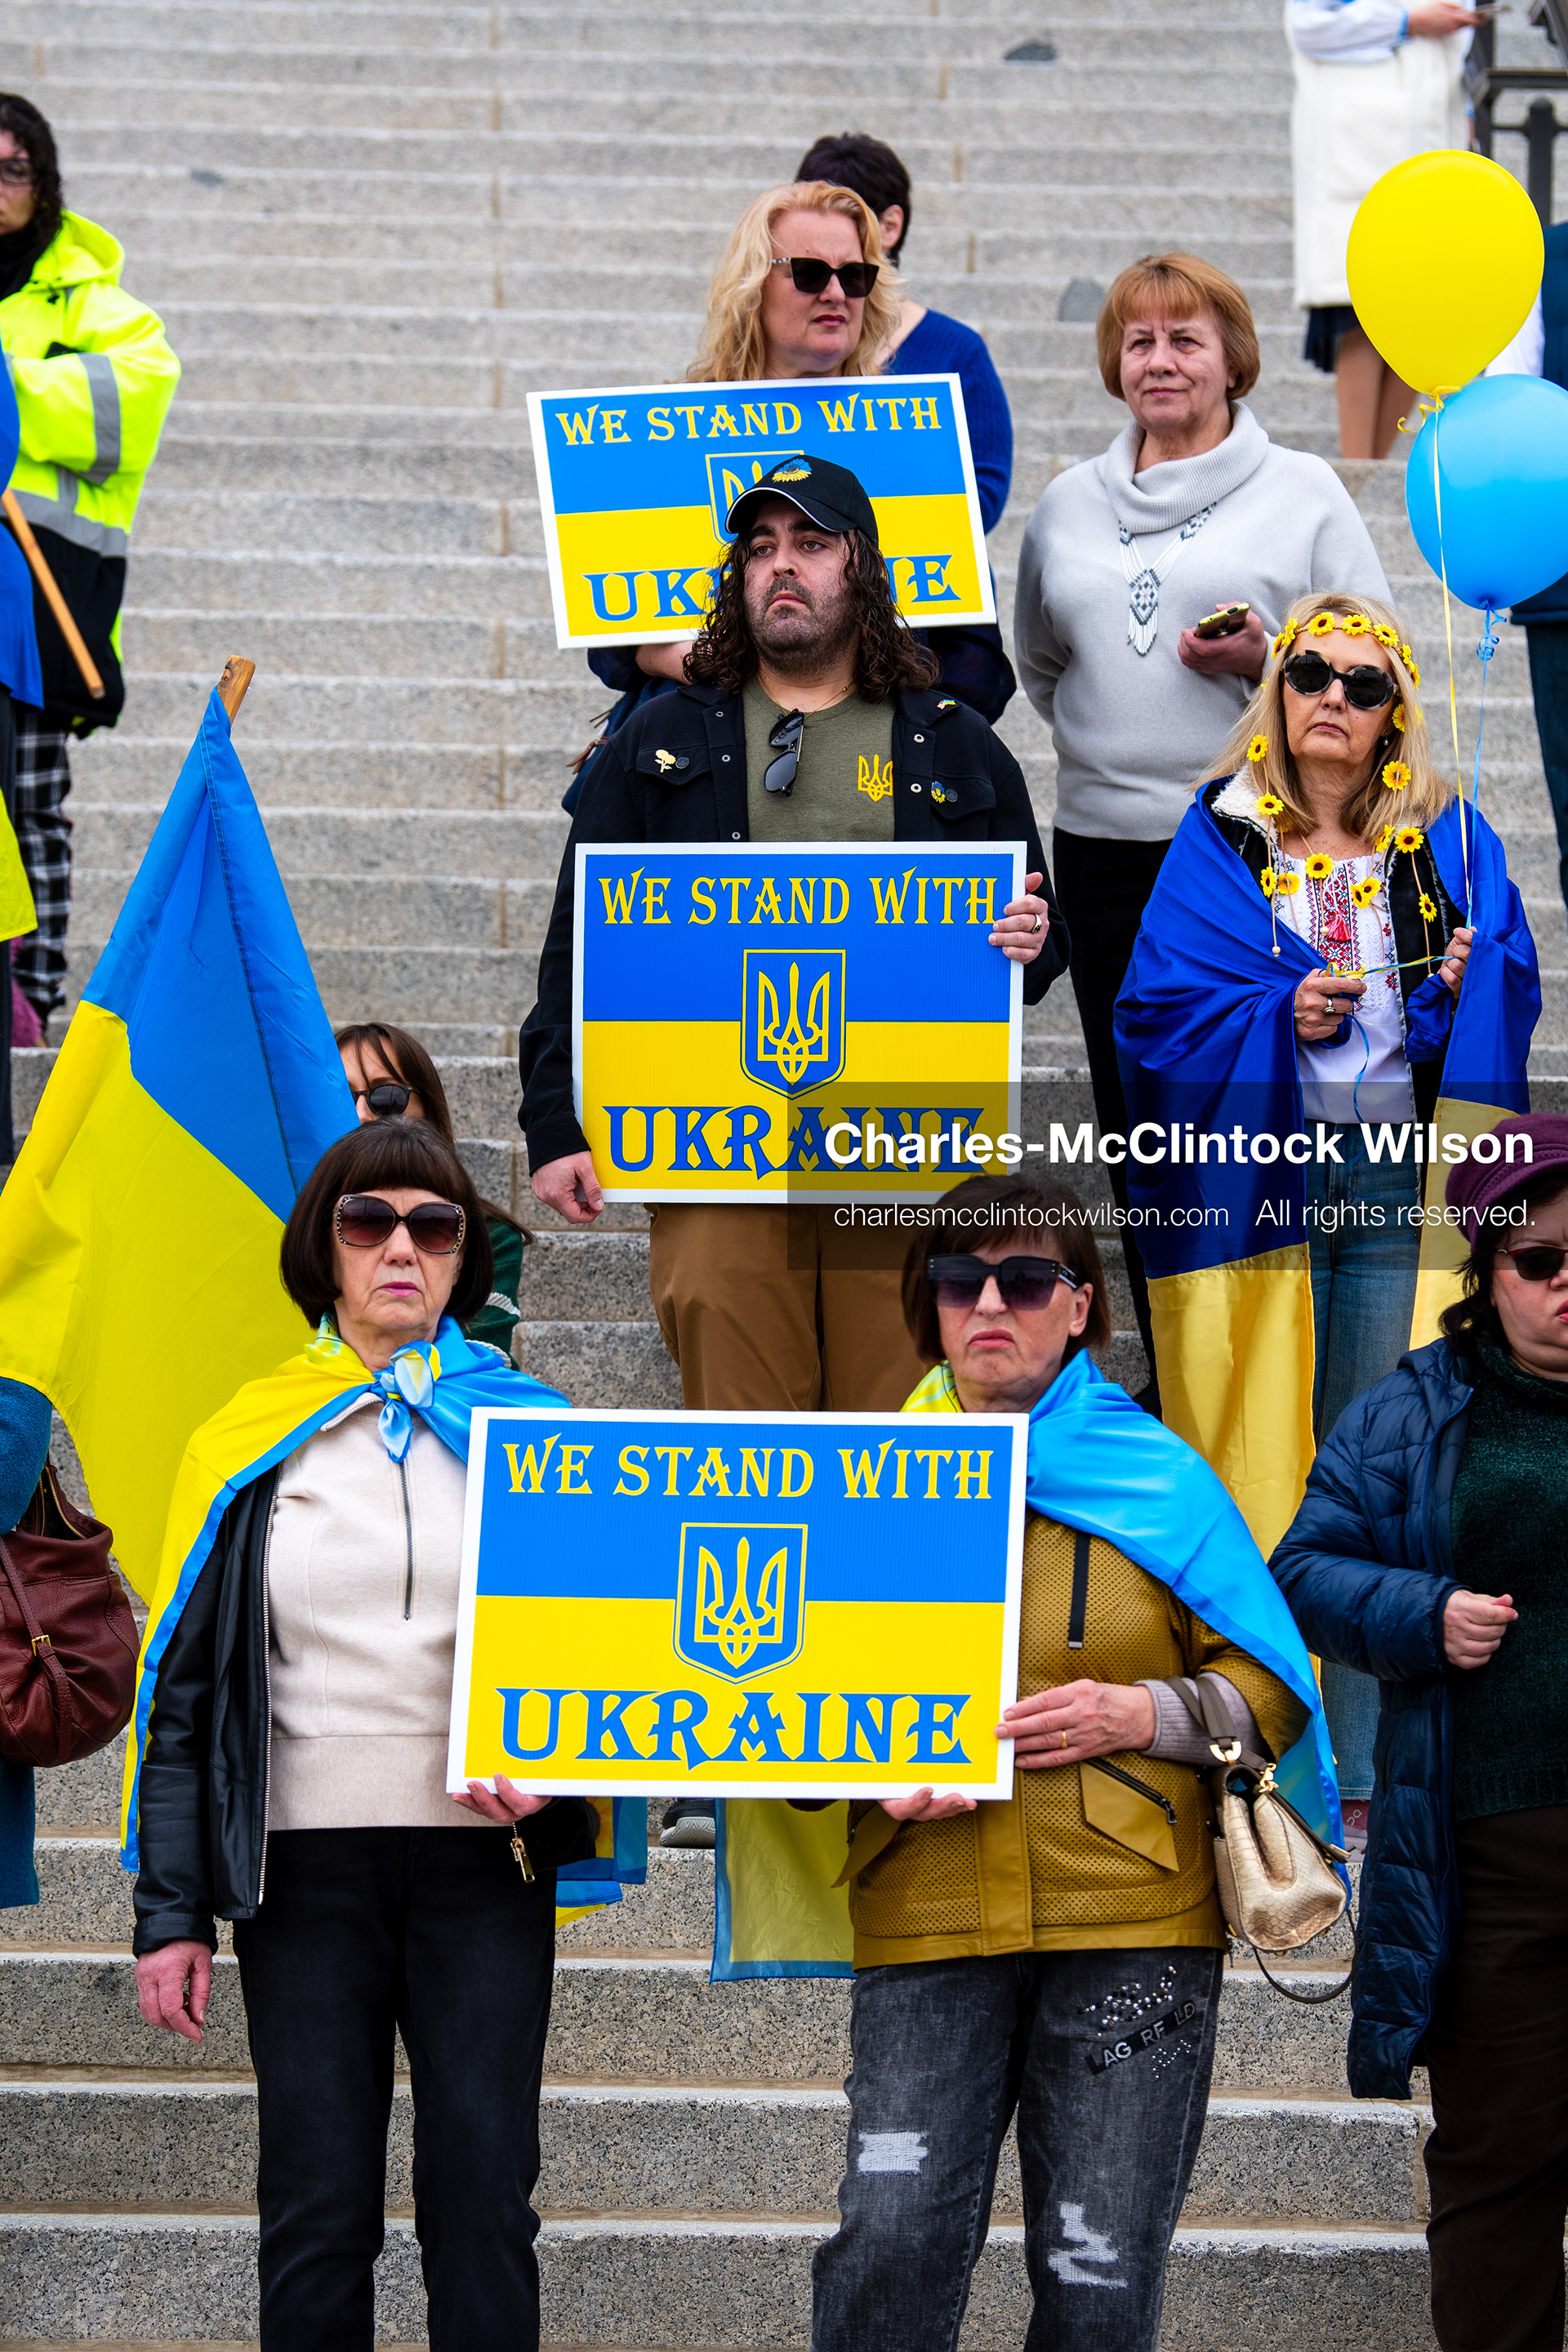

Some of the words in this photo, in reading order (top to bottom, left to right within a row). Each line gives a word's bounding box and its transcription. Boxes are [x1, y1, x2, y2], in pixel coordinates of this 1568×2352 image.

[555, 403, 632, 445] WE
[648, 402, 803, 441] STAND
[817, 393, 942, 433] WITH
[598, 862, 672, 924] WE
[687, 876, 850, 926] STAND
[869, 861, 1000, 924] WITH
[602, 1105, 986, 1181] UKRAINE
[501, 1432, 595, 1494] WE
[612, 1445, 815, 1498] STAND
[837, 1437, 994, 1499] WITH
[495, 1687, 973, 1771] UKRAINE
